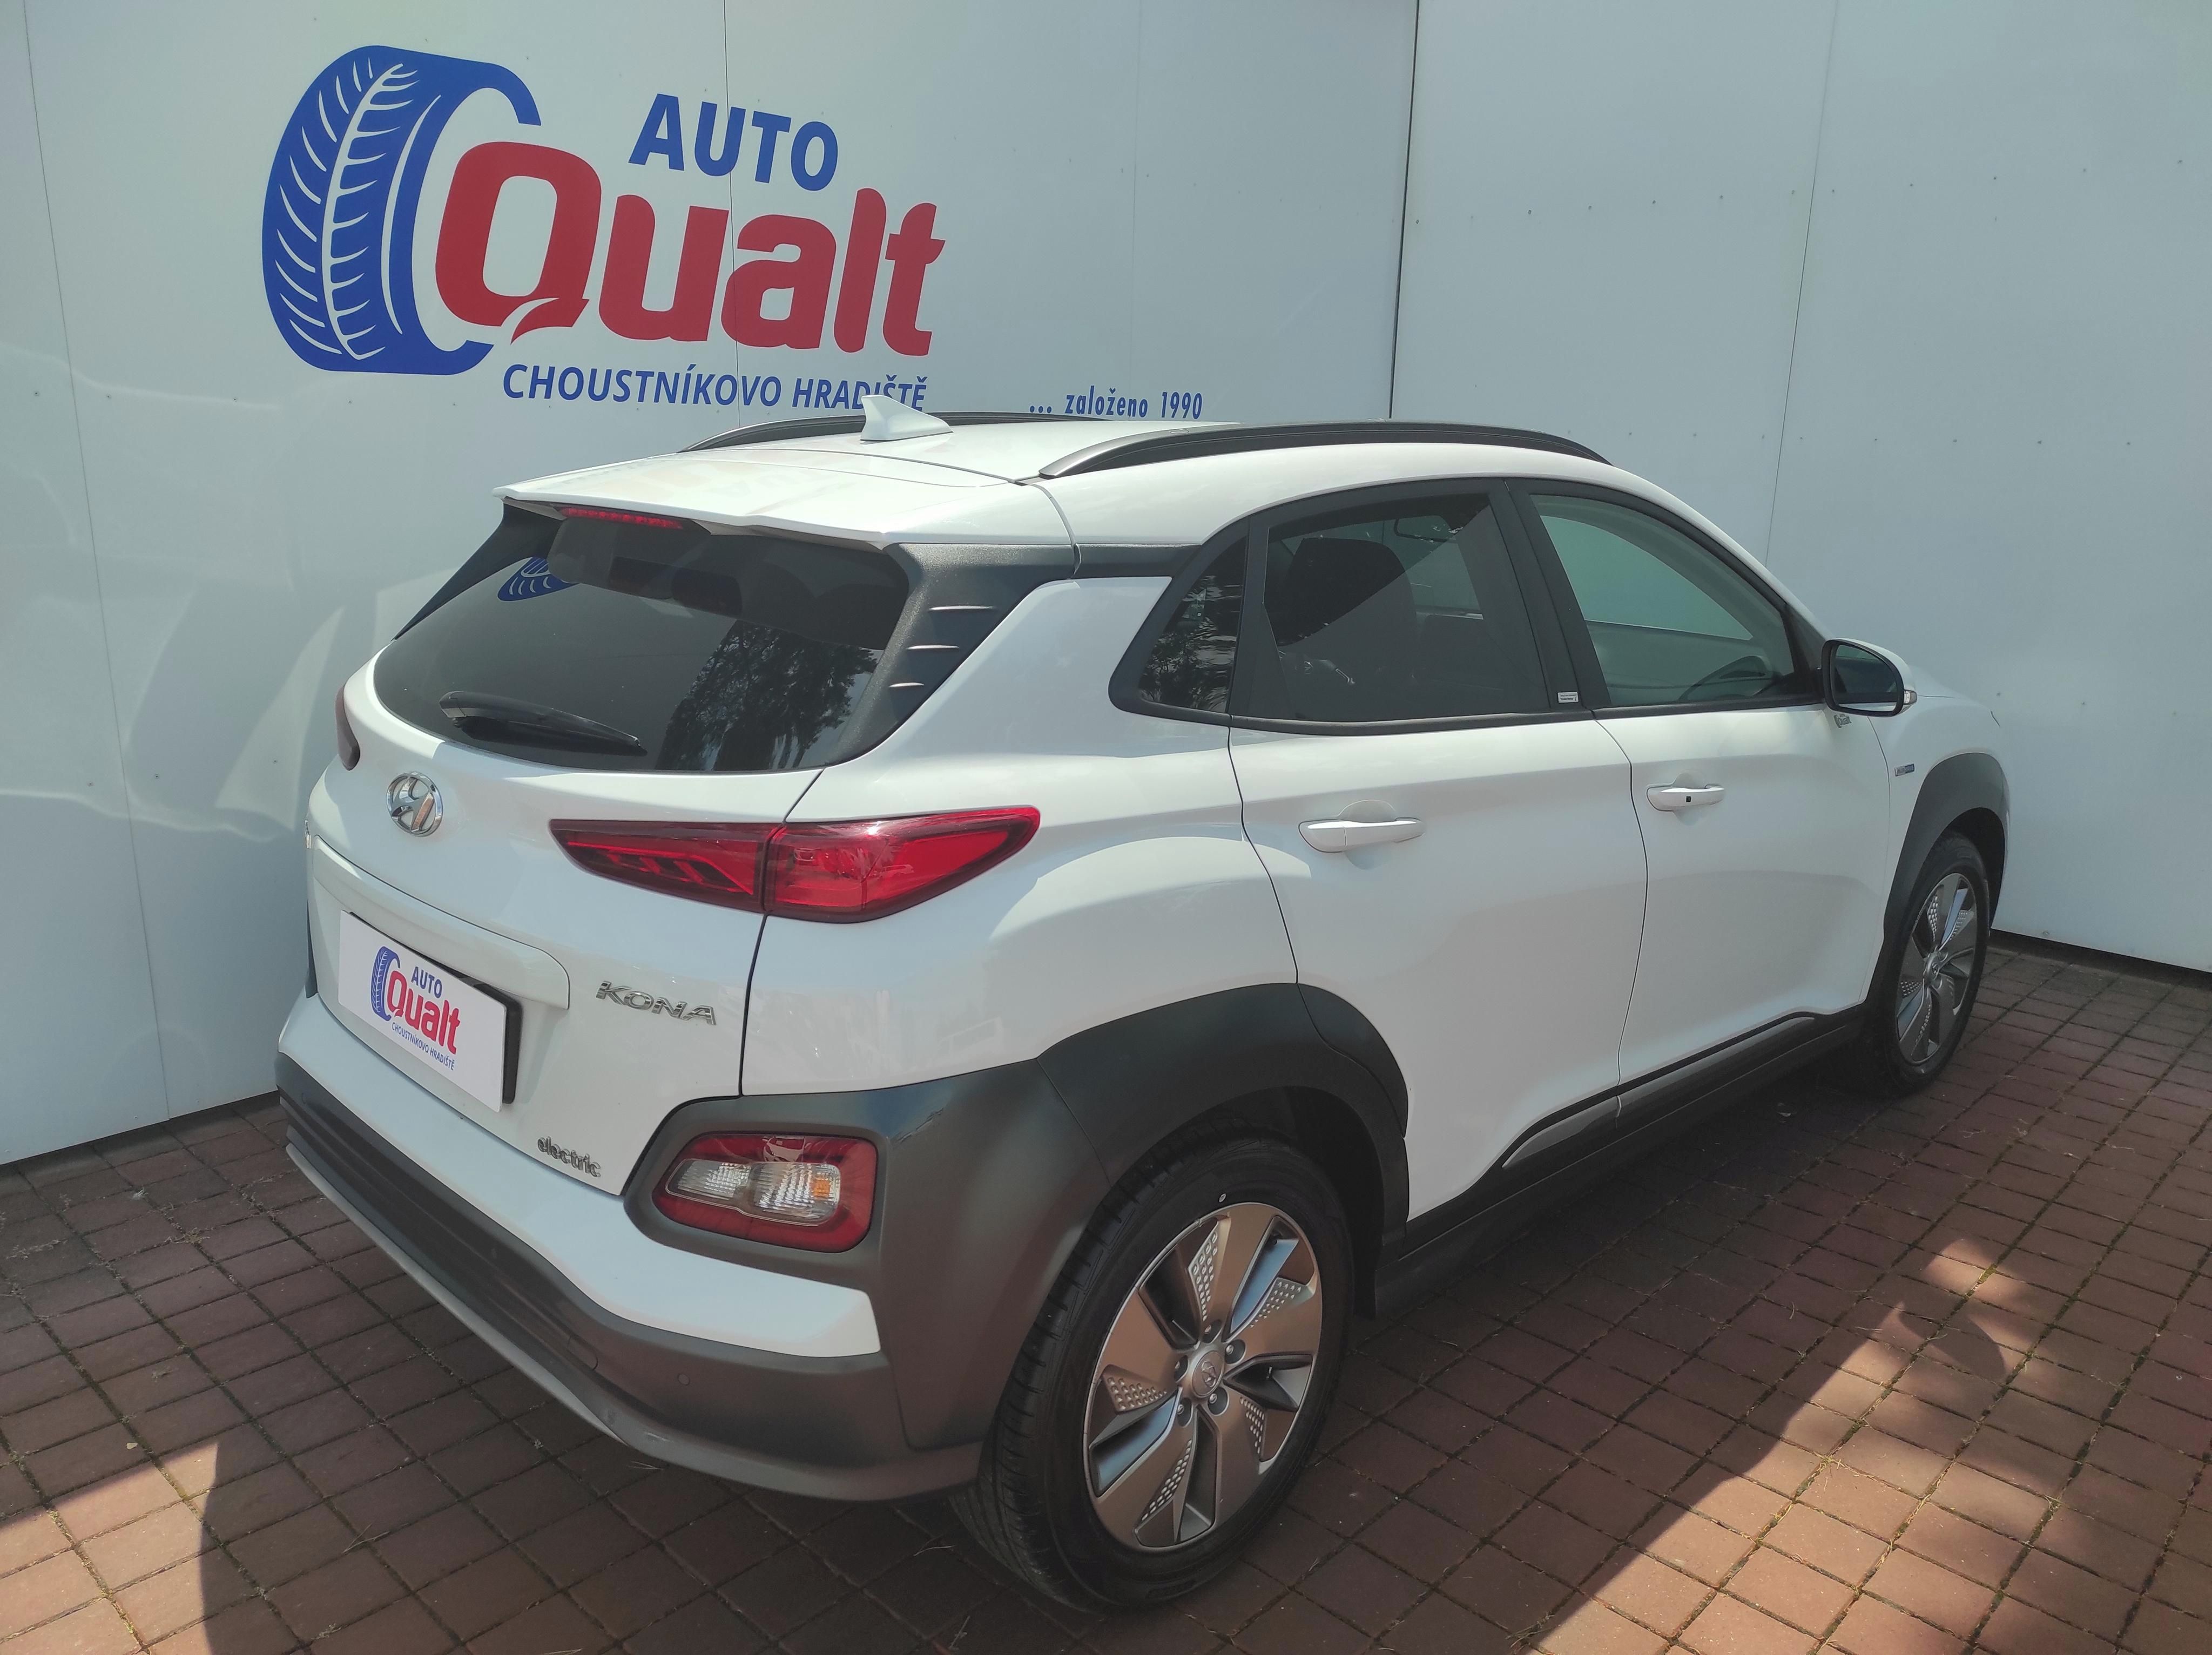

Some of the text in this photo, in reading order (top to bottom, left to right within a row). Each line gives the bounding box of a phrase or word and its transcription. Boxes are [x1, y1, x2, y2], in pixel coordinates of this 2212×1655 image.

[629, 93, 838, 191] AUTO
[435, 141, 945, 356] Qualt
[503, 363, 782, 407] CHOUSTNÍKOVO
[1065, 385, 1148, 418] založeno
[1161, 391, 1203, 420] 1990
[411, 966, 442, 998] AUTO
[596, 980, 717, 1025] KONA
[387, 970, 461, 1055] Qualt
[392, 1022, 455, 1071] CHOUSTNÍKOVO HRADIŠTĚ
[537, 1136, 601, 1178] electric
